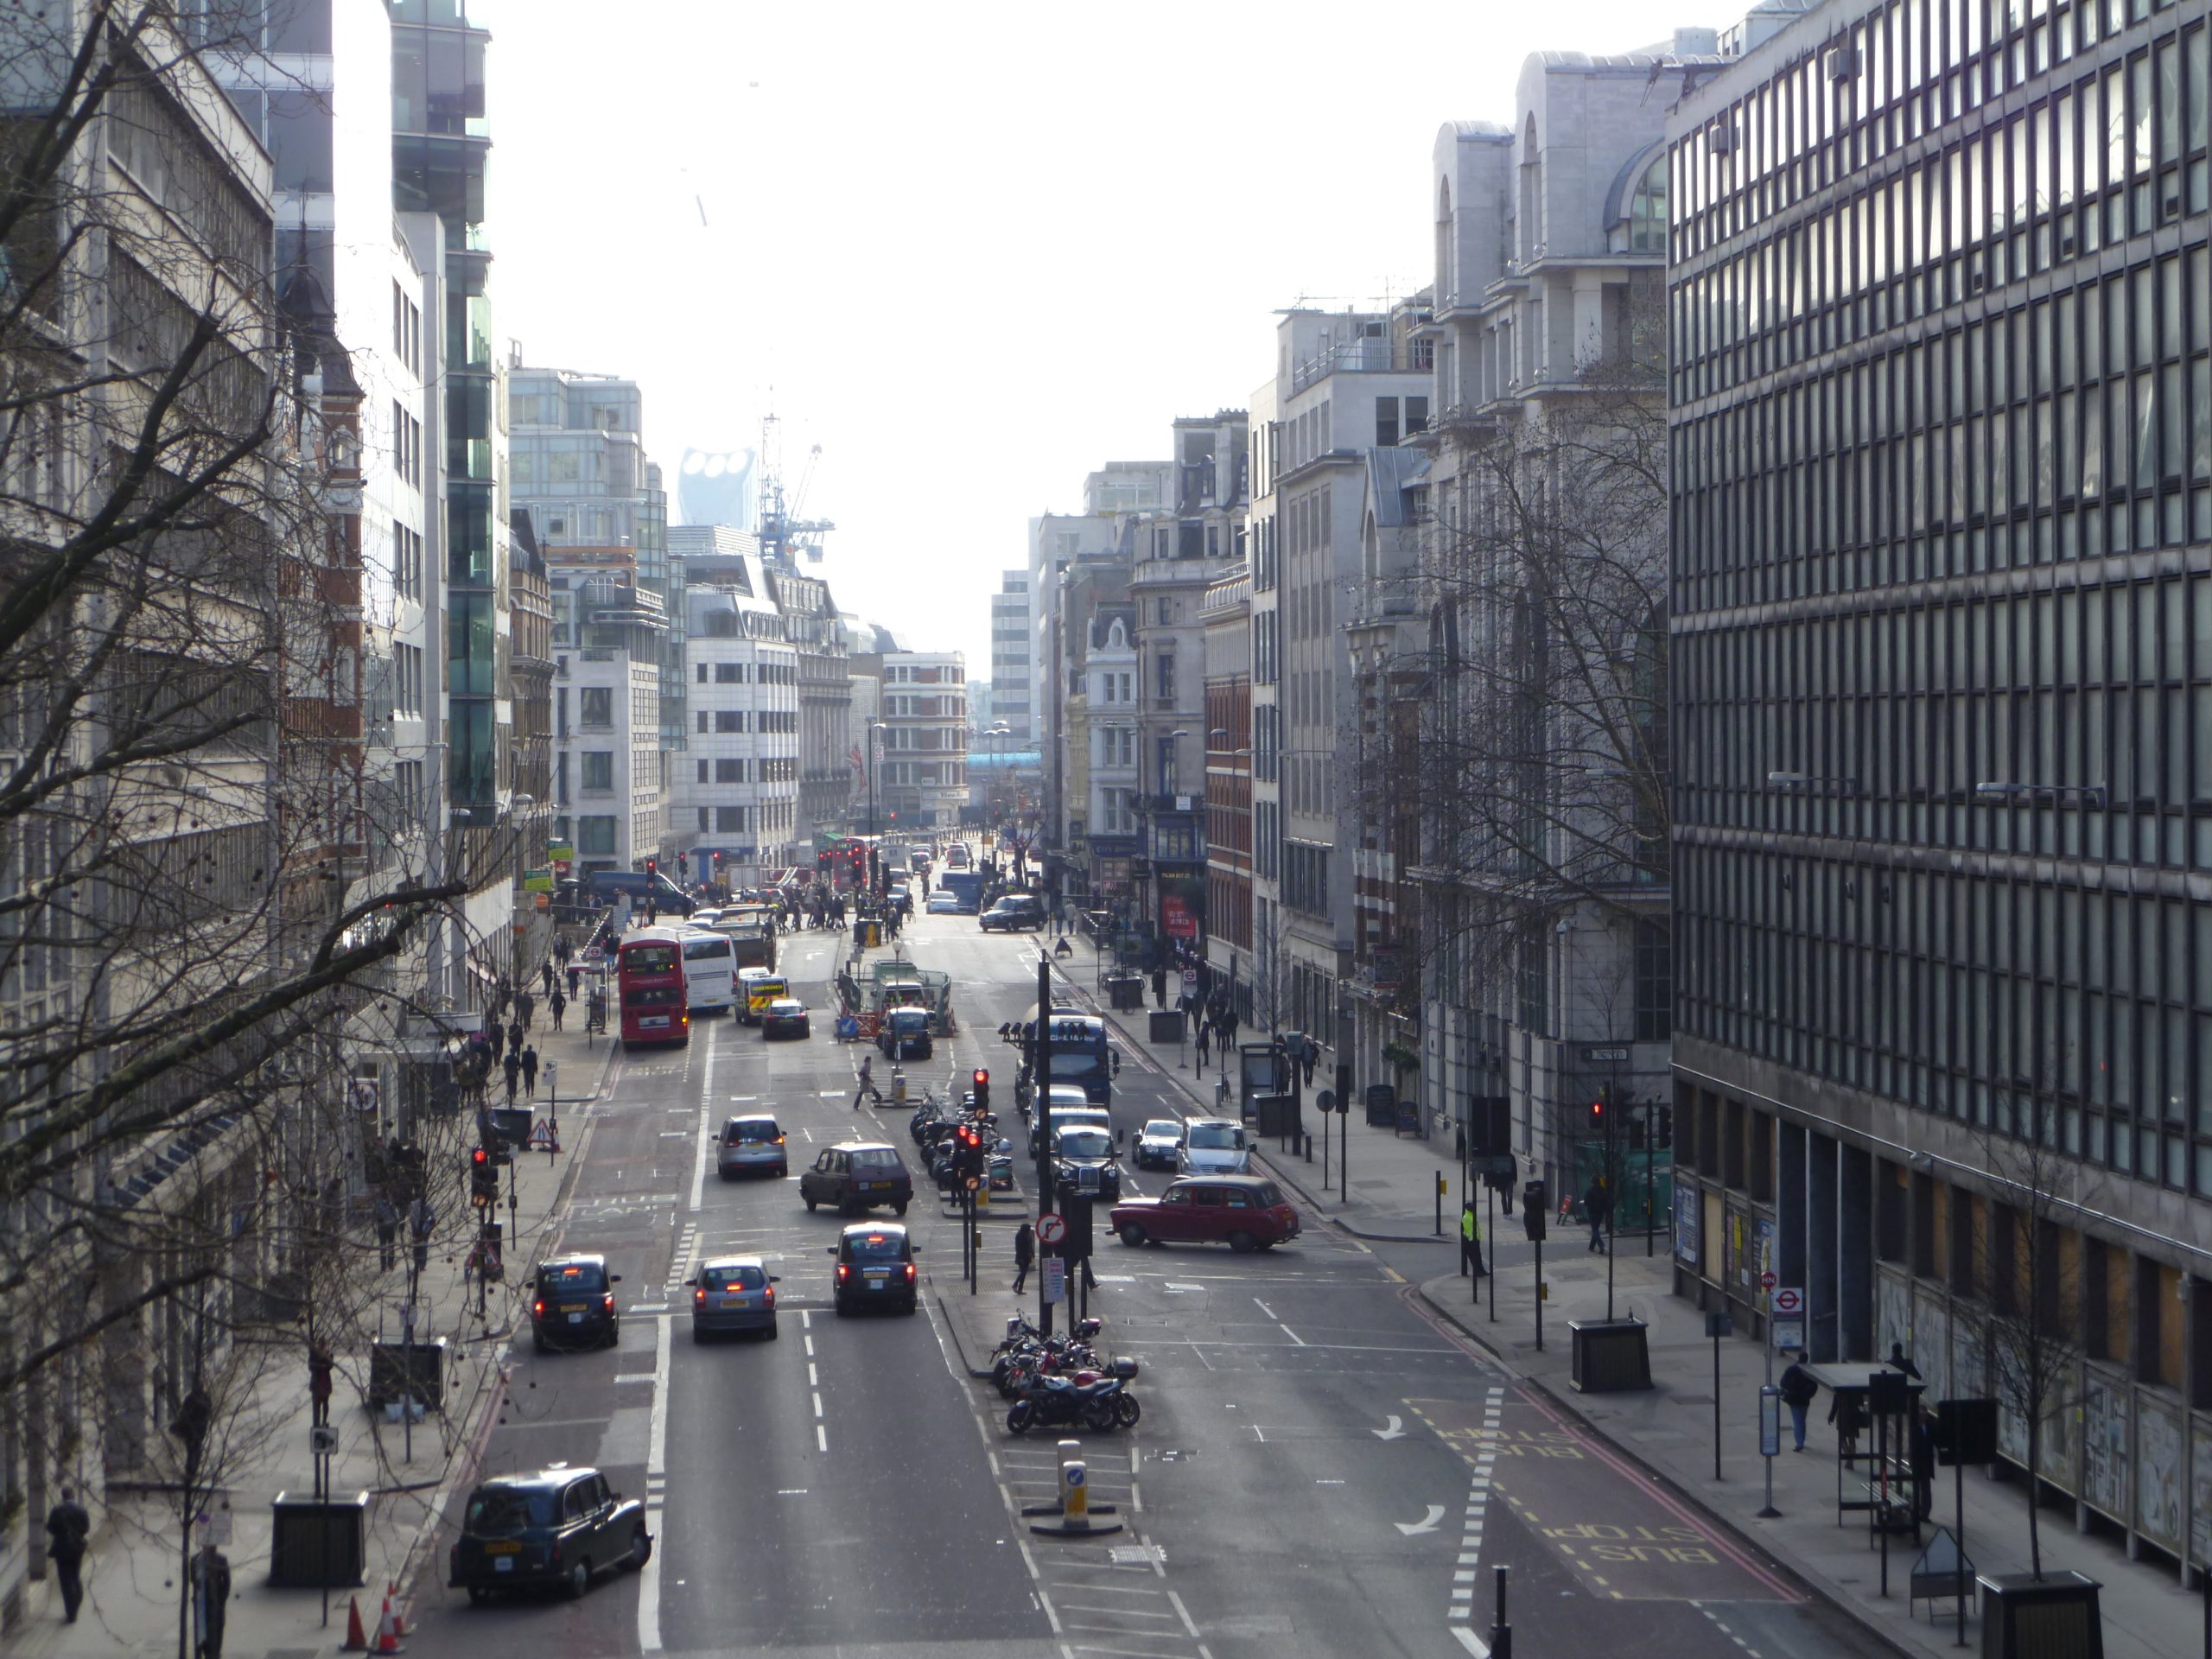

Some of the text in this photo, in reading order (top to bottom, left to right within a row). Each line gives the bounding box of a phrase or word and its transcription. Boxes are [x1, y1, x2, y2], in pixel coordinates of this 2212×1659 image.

[1474, 1442, 1584, 1459] BUS
[1554, 1523, 1706, 1542] STOP
[1590, 1545, 1719, 1563] BUS
